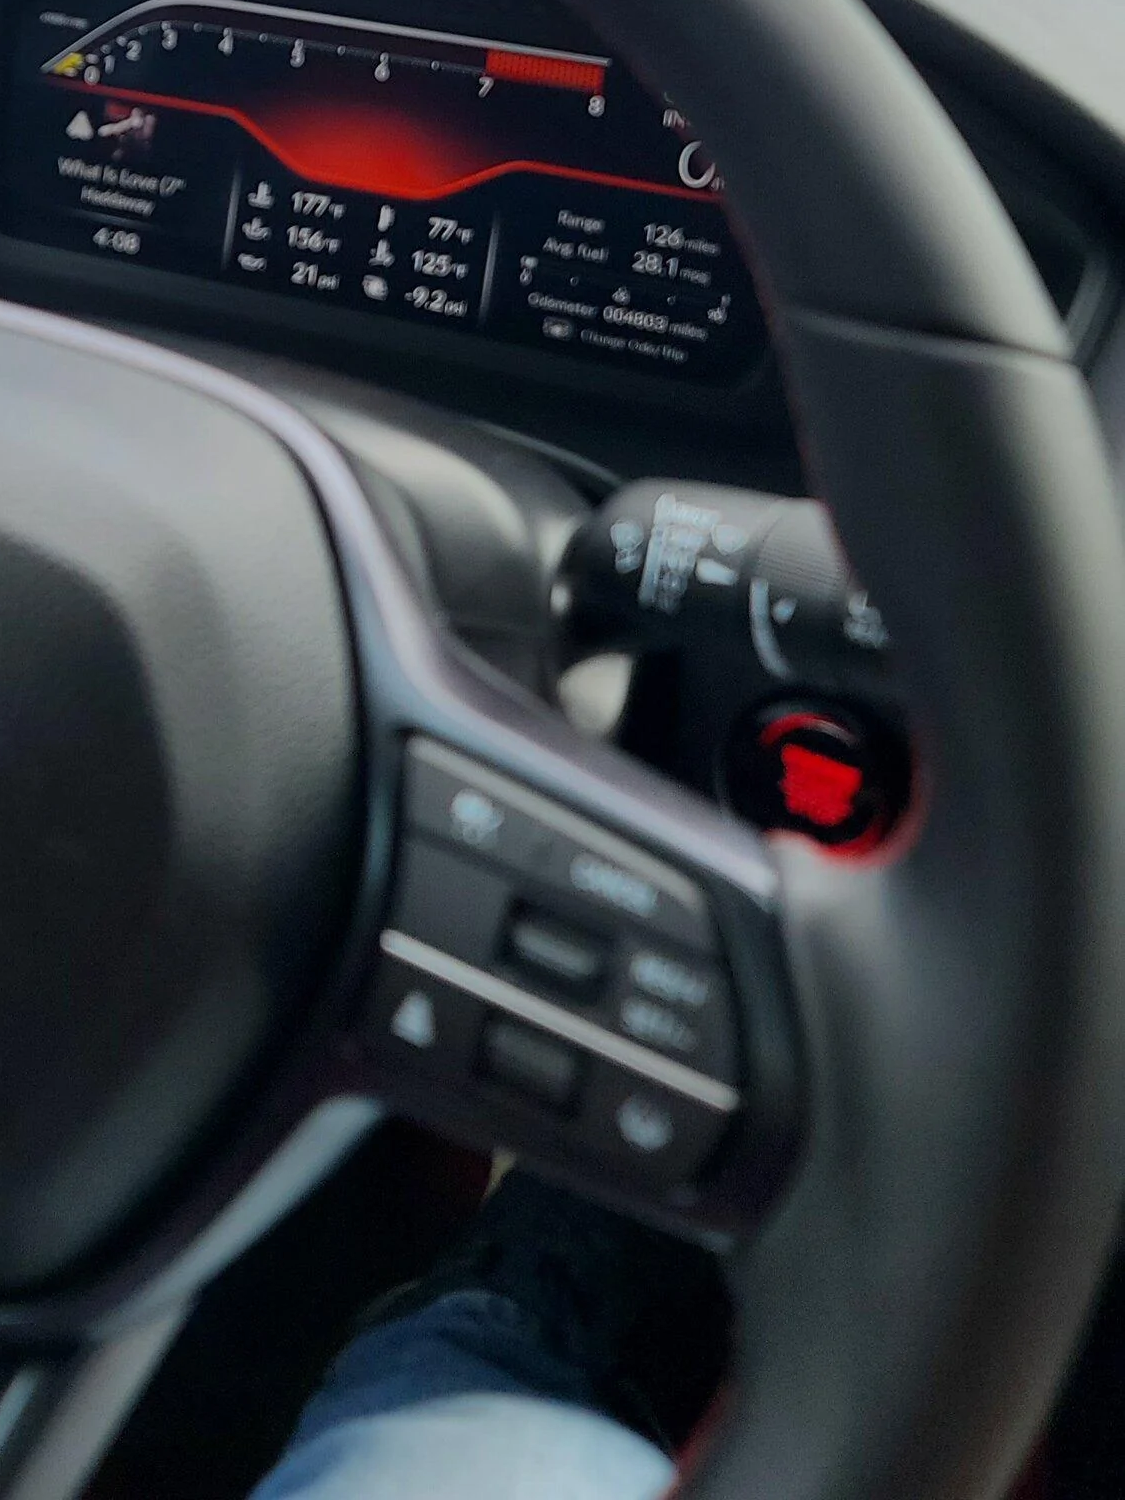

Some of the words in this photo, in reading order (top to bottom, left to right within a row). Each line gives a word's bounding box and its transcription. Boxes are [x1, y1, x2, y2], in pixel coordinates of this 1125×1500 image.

[126, 39, 142, 62] 2
[375, 61, 390, 82] 6
[479, 76, 494, 98] 7
[588, 95, 605, 117] 8
[557, 209, 606, 235] Range
[643, 222, 685, 250] 126
[631, 250, 679, 279] 28.1
